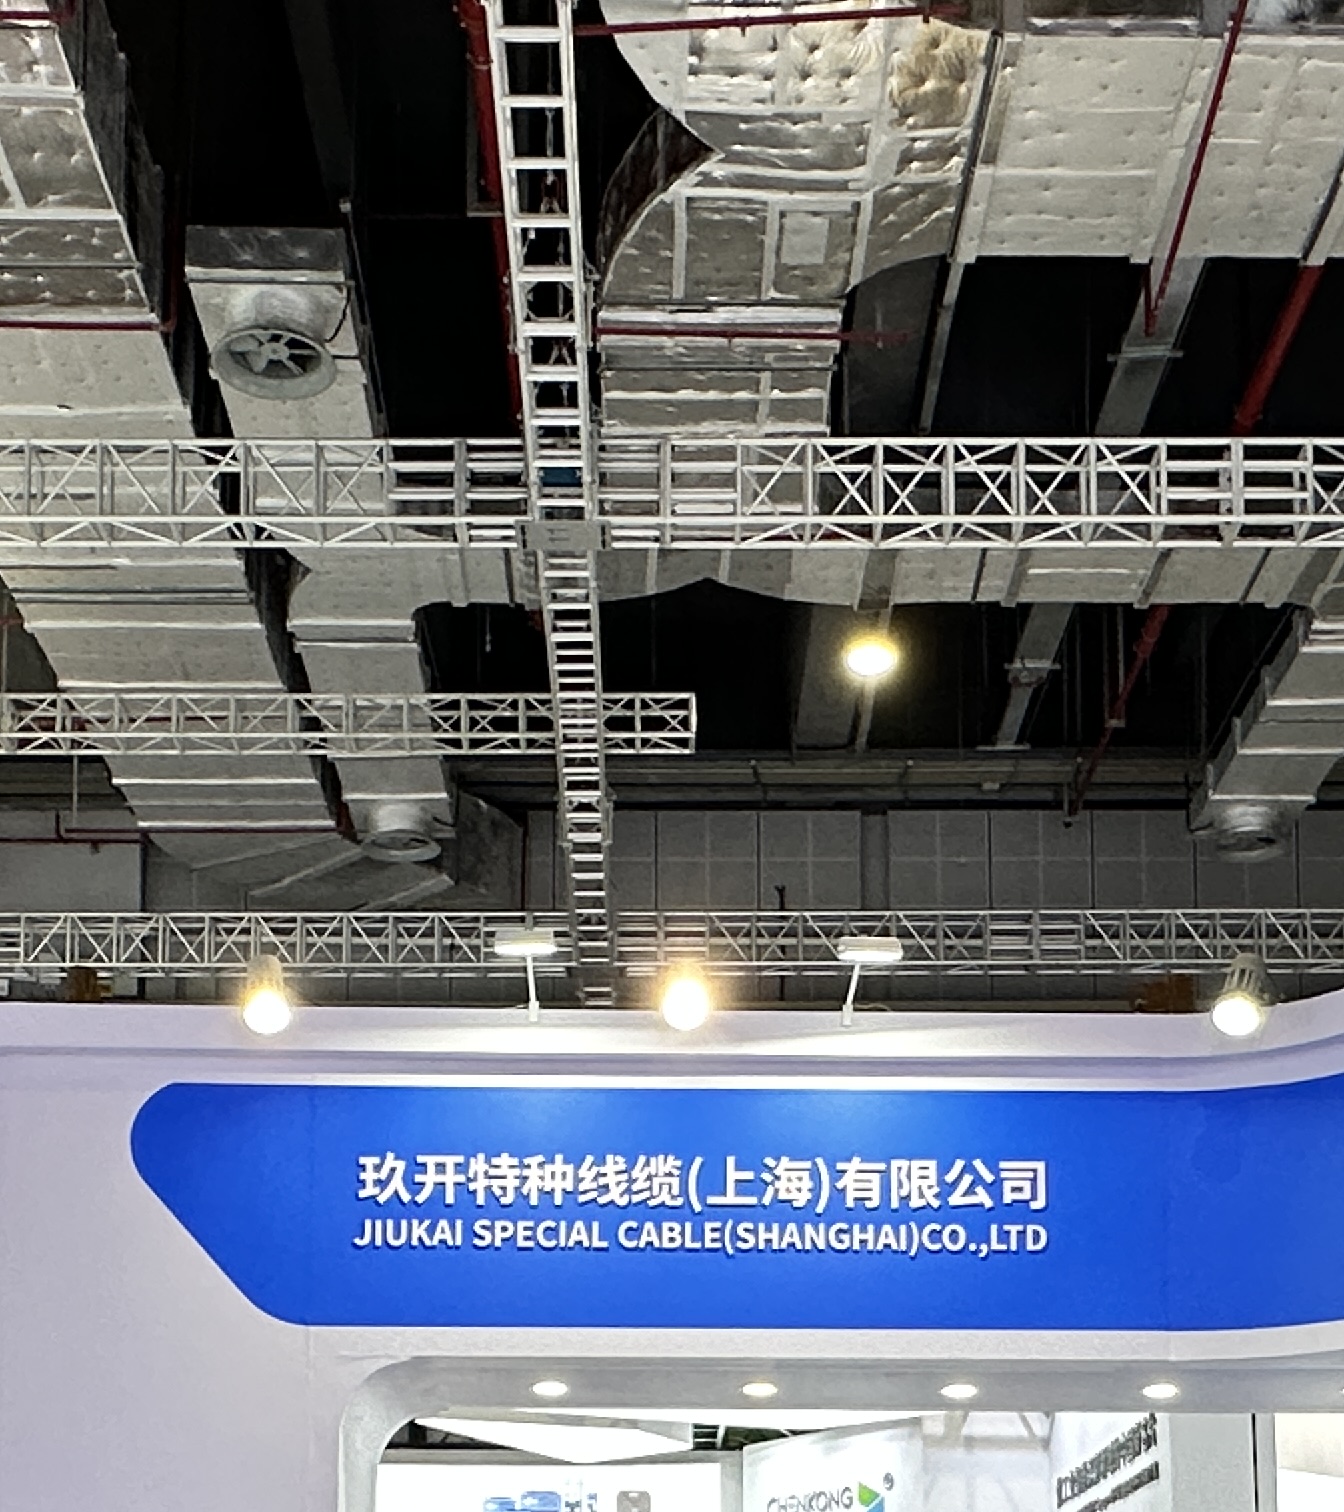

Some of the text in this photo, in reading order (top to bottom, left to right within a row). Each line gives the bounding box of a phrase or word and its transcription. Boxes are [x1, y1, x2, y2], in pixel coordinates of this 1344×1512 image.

[357, 1151, 1048, 1213] 玖开特种线缆(上海)有限公司
[353, 1218, 1048, 1256] JIUKAI SPECIAL CABLE(SHANGHAI)CO.,LTD
